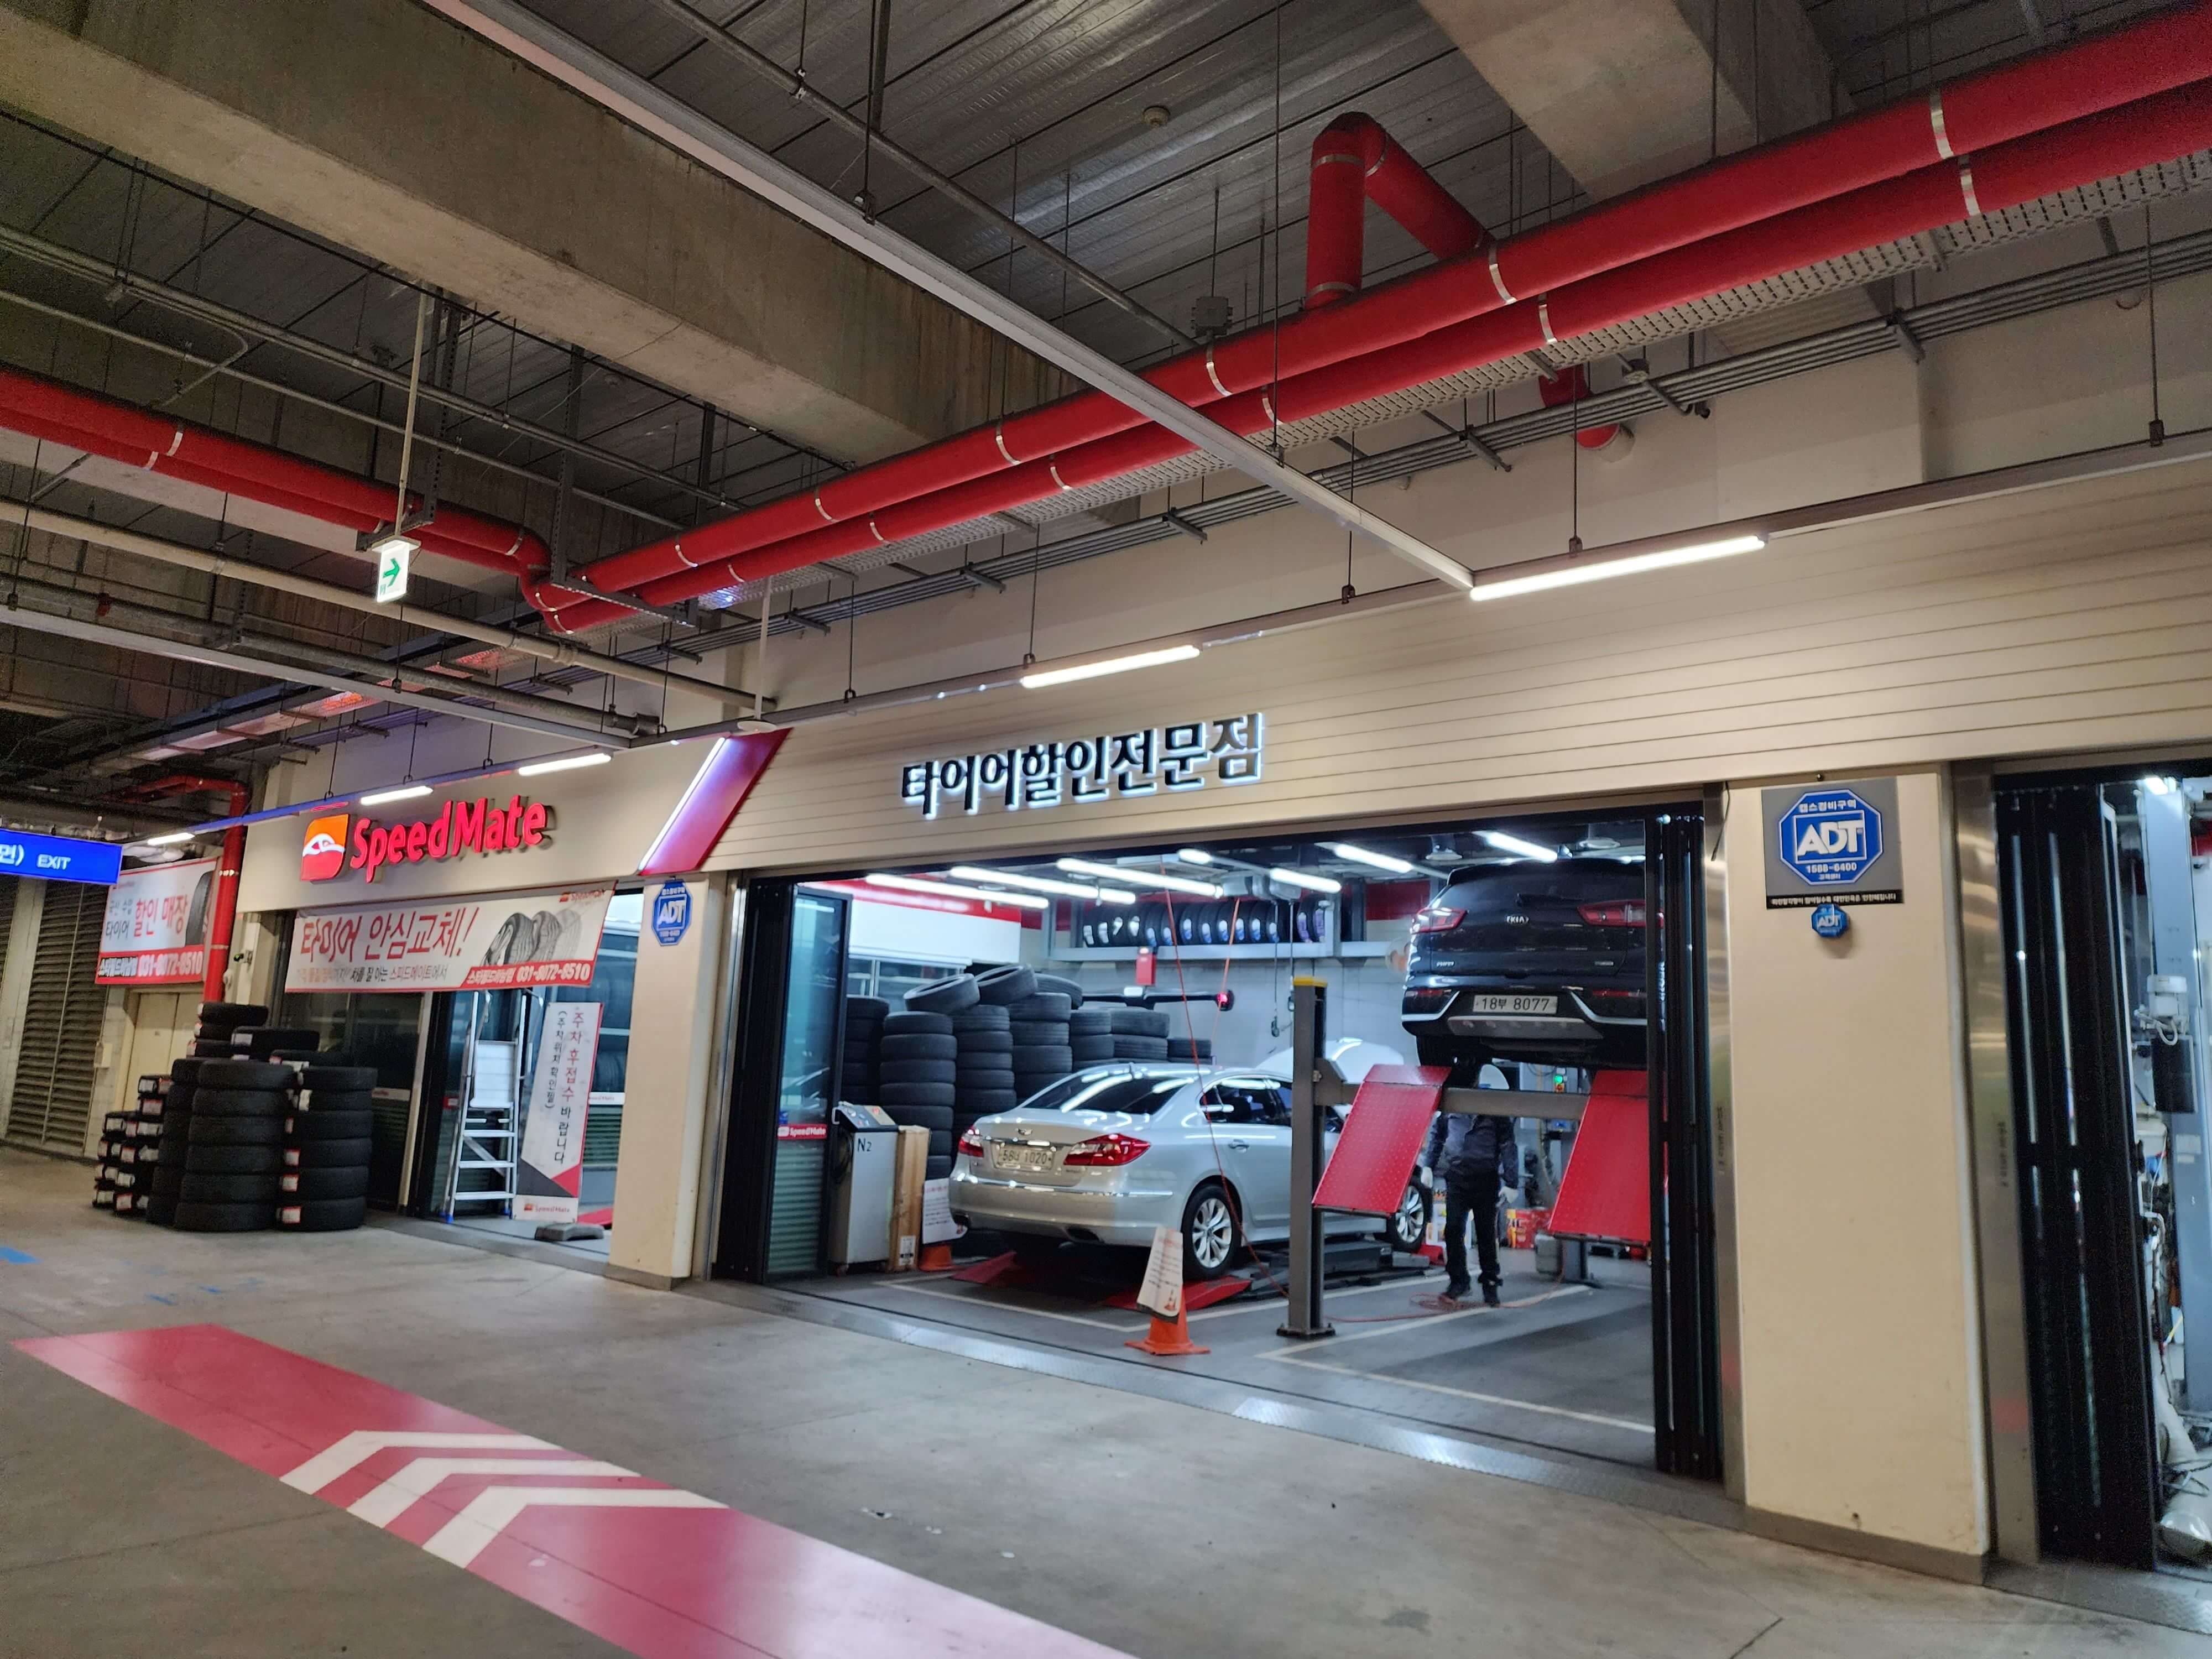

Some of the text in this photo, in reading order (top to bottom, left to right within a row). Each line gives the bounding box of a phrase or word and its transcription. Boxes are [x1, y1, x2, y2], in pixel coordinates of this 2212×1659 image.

[902, 713, 1264, 817] 타이어할인전문점
[349, 795, 546, 883] SpeedMate
[1797, 820, 1864, 856] ADT
[36, 854, 71, 870] EXIT
[134, 894, 188, 937] 할인 매장
[657, 900, 686, 925] ADT
[1509, 916, 1526, 925] KIA
[1818, 915, 1841, 927] ADT
[106, 920, 129, 940] 타이어
[300, 907, 479, 962] 타이어 안심교체!
[1482, 997, 1550, 1011] 18부 8077
[790, 1127, 826, 1138] SpeedMate
[858, 1137, 872, 1152] N2
[1025, 1151, 1048, 1165] 1020
